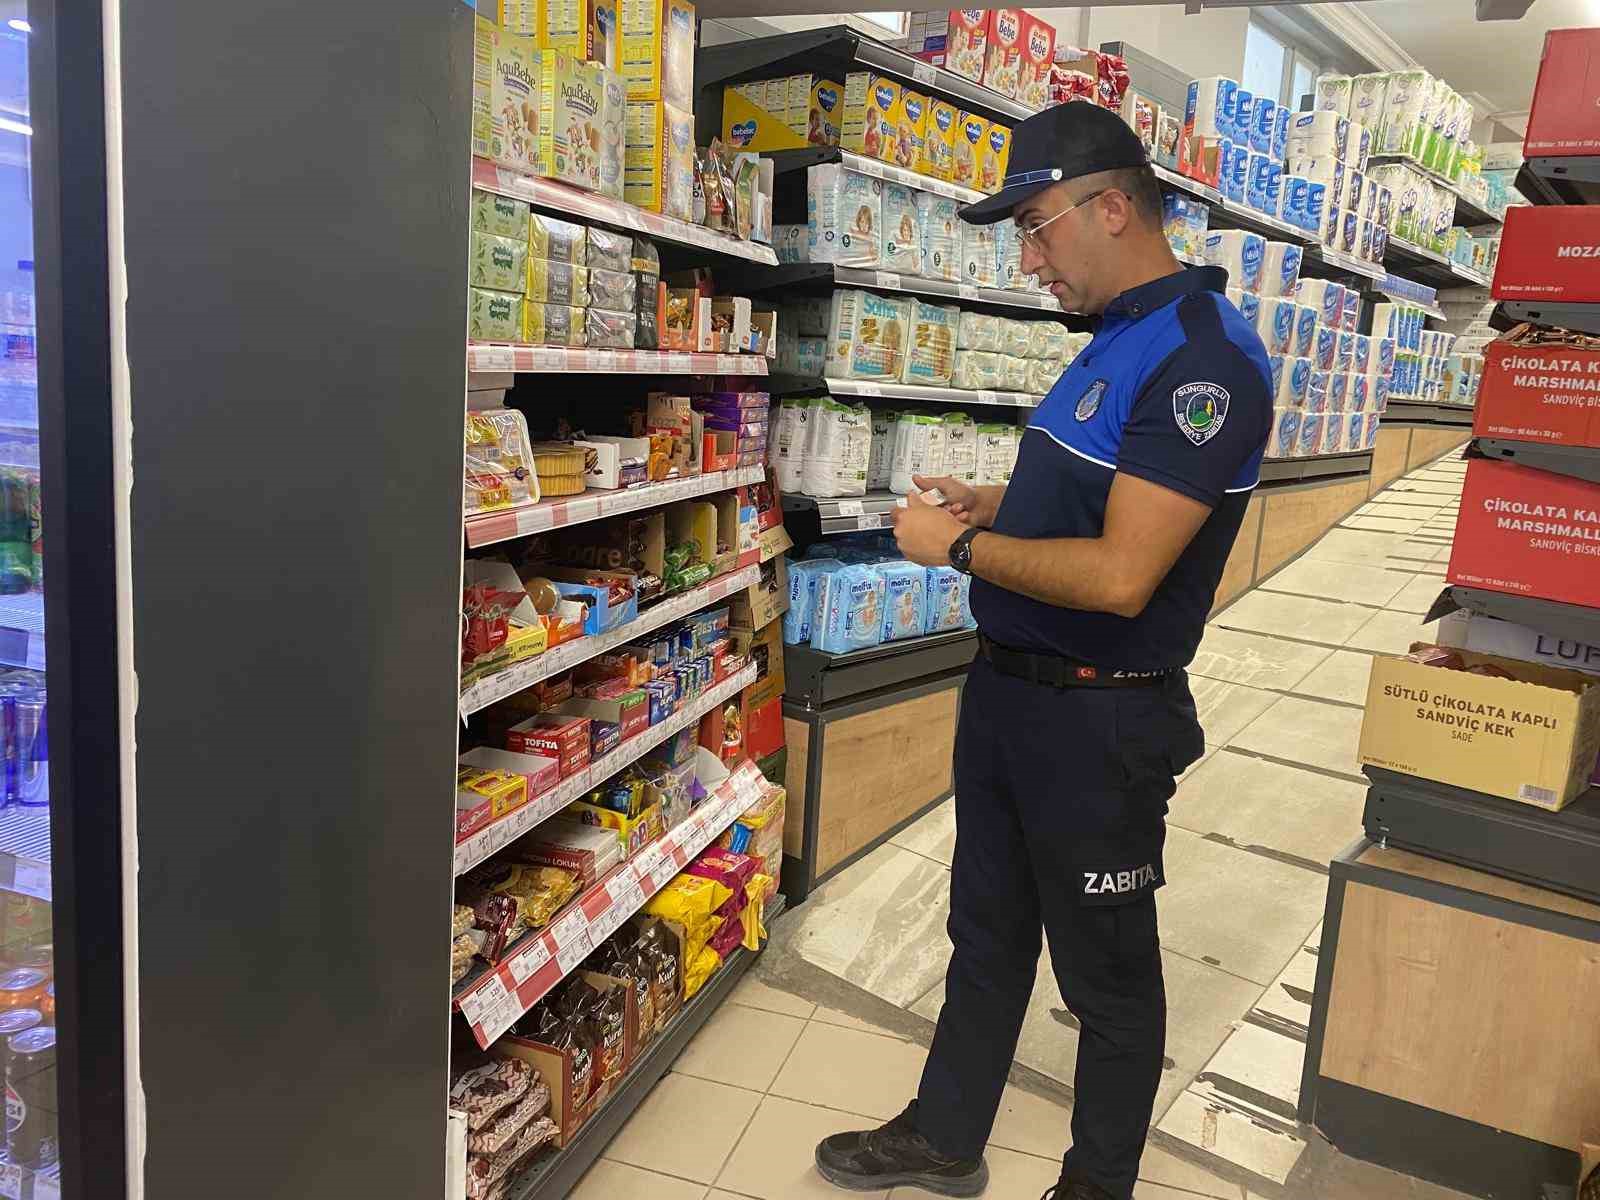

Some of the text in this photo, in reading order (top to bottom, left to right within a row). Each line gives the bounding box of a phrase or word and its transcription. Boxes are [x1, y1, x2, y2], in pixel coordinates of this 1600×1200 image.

[998, 19, 1015, 40] Bebe
[1030, 37, 1047, 57] Bebe
[1501, 356, 1582, 373] ÇİKOLATA
[1177, 385, 1227, 400] SUNGURLU
[1543, 393, 1586, 407] SANDVİÇ
[1483, 497, 1567, 519] ÇİKOLATA
[1529, 537, 1573, 554] SANDVİÇ
[851, 580, 873, 593] molfix
[890, 578, 911, 588] molfix
[939, 575, 959, 585] molfix
[1384, 684, 1557, 730] SÜTLÜ ÇİKOLATA KAPLI
[1416, 708, 1515, 738] SANDVİÇ KEK
[1451, 730, 1473, 743] SADE
[1084, 864, 1157, 893] ZABITA
